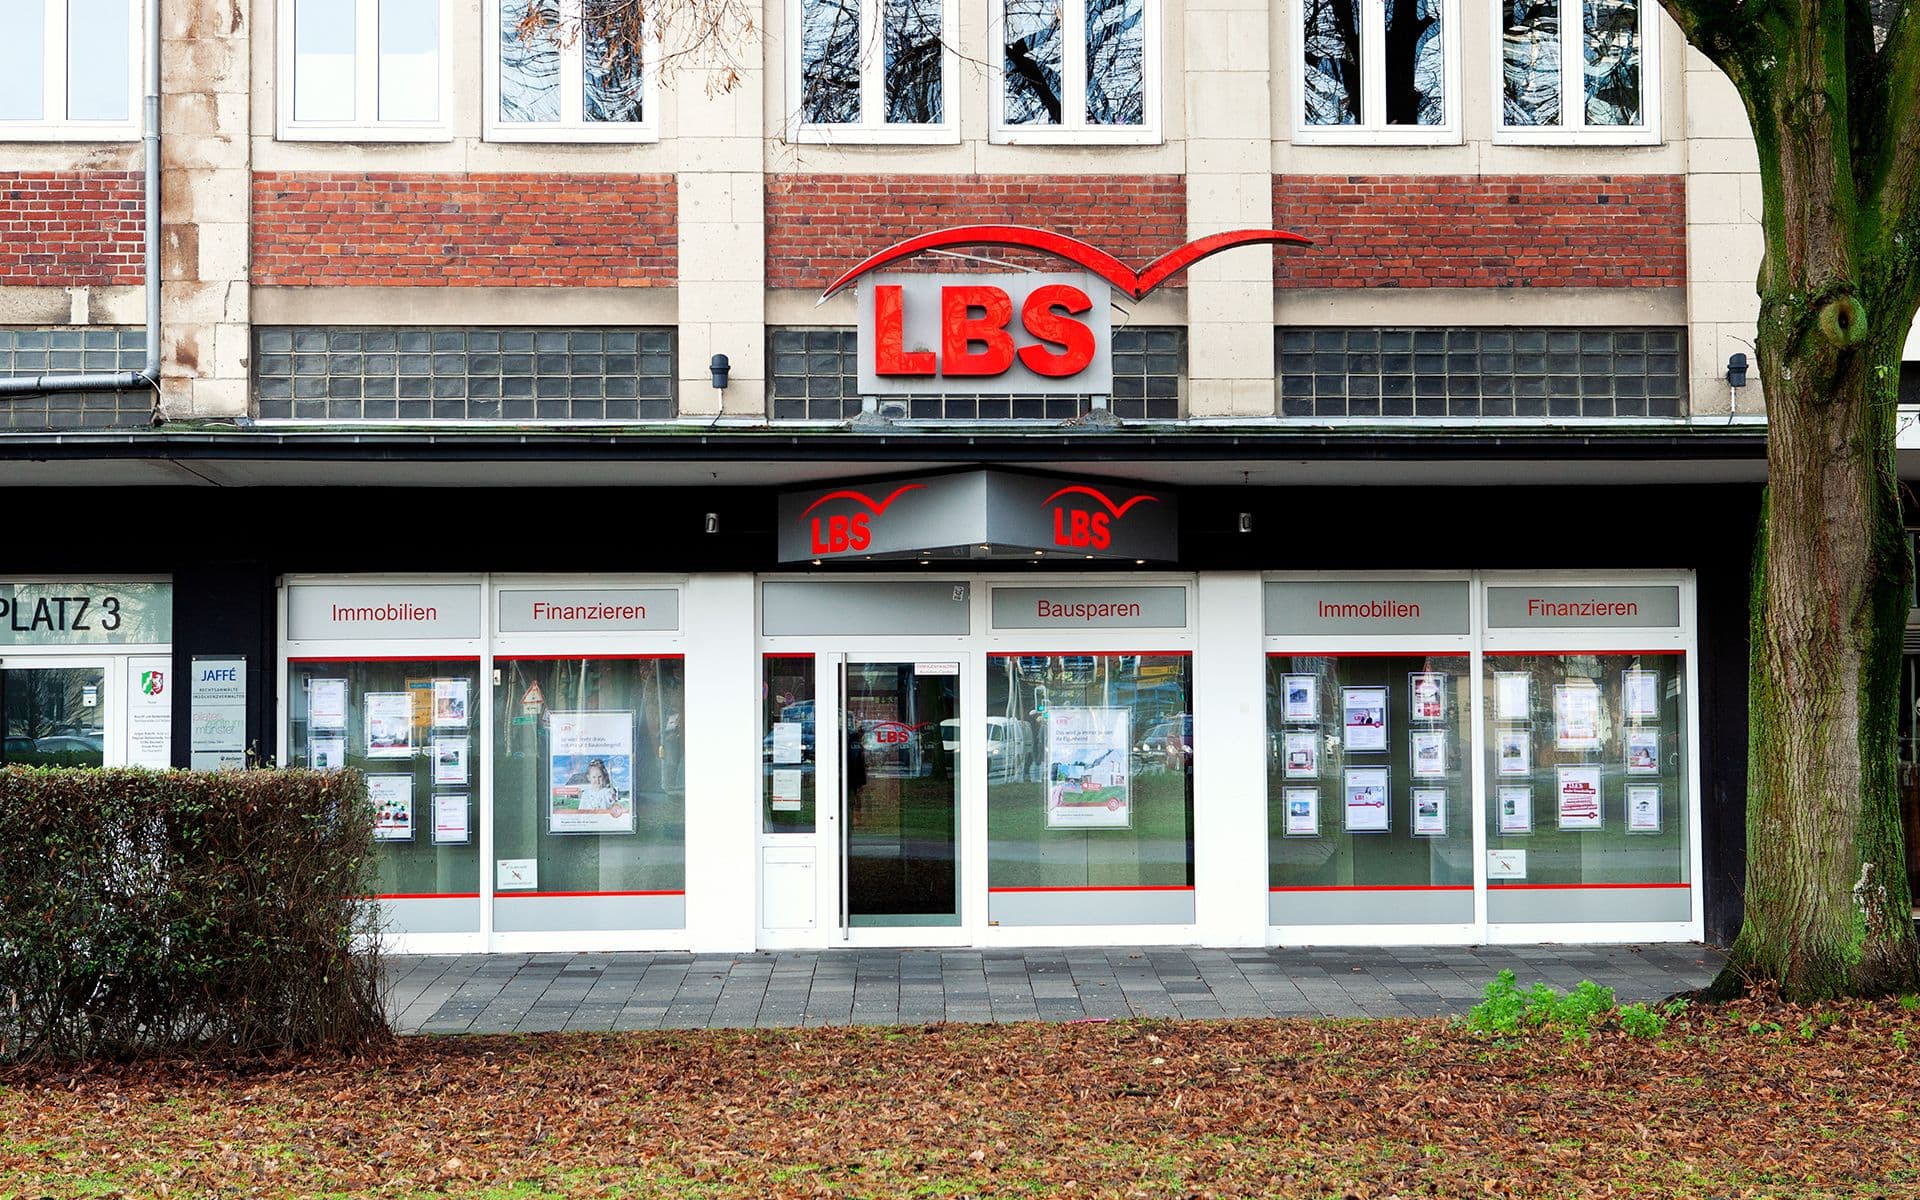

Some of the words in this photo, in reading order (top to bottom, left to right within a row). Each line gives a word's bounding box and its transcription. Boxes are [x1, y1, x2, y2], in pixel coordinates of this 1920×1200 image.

[875, 284, 1096, 377] LBS
[811, 512, 872, 555] LBS
[1054, 507, 1111, 550] LBS
[101, 597, 121, 631] 3
[332, 603, 437, 621] Immobilien
[533, 601, 646, 620] Finanzieren
[1037, 600, 1140, 621] Bausparen
[1318, 600, 1420, 618] Immobilien
[1527, 598, 1638, 617] Finanzieren
[201, 667, 237, 682] JAFFÉ
[876, 731, 909, 743] LBS
